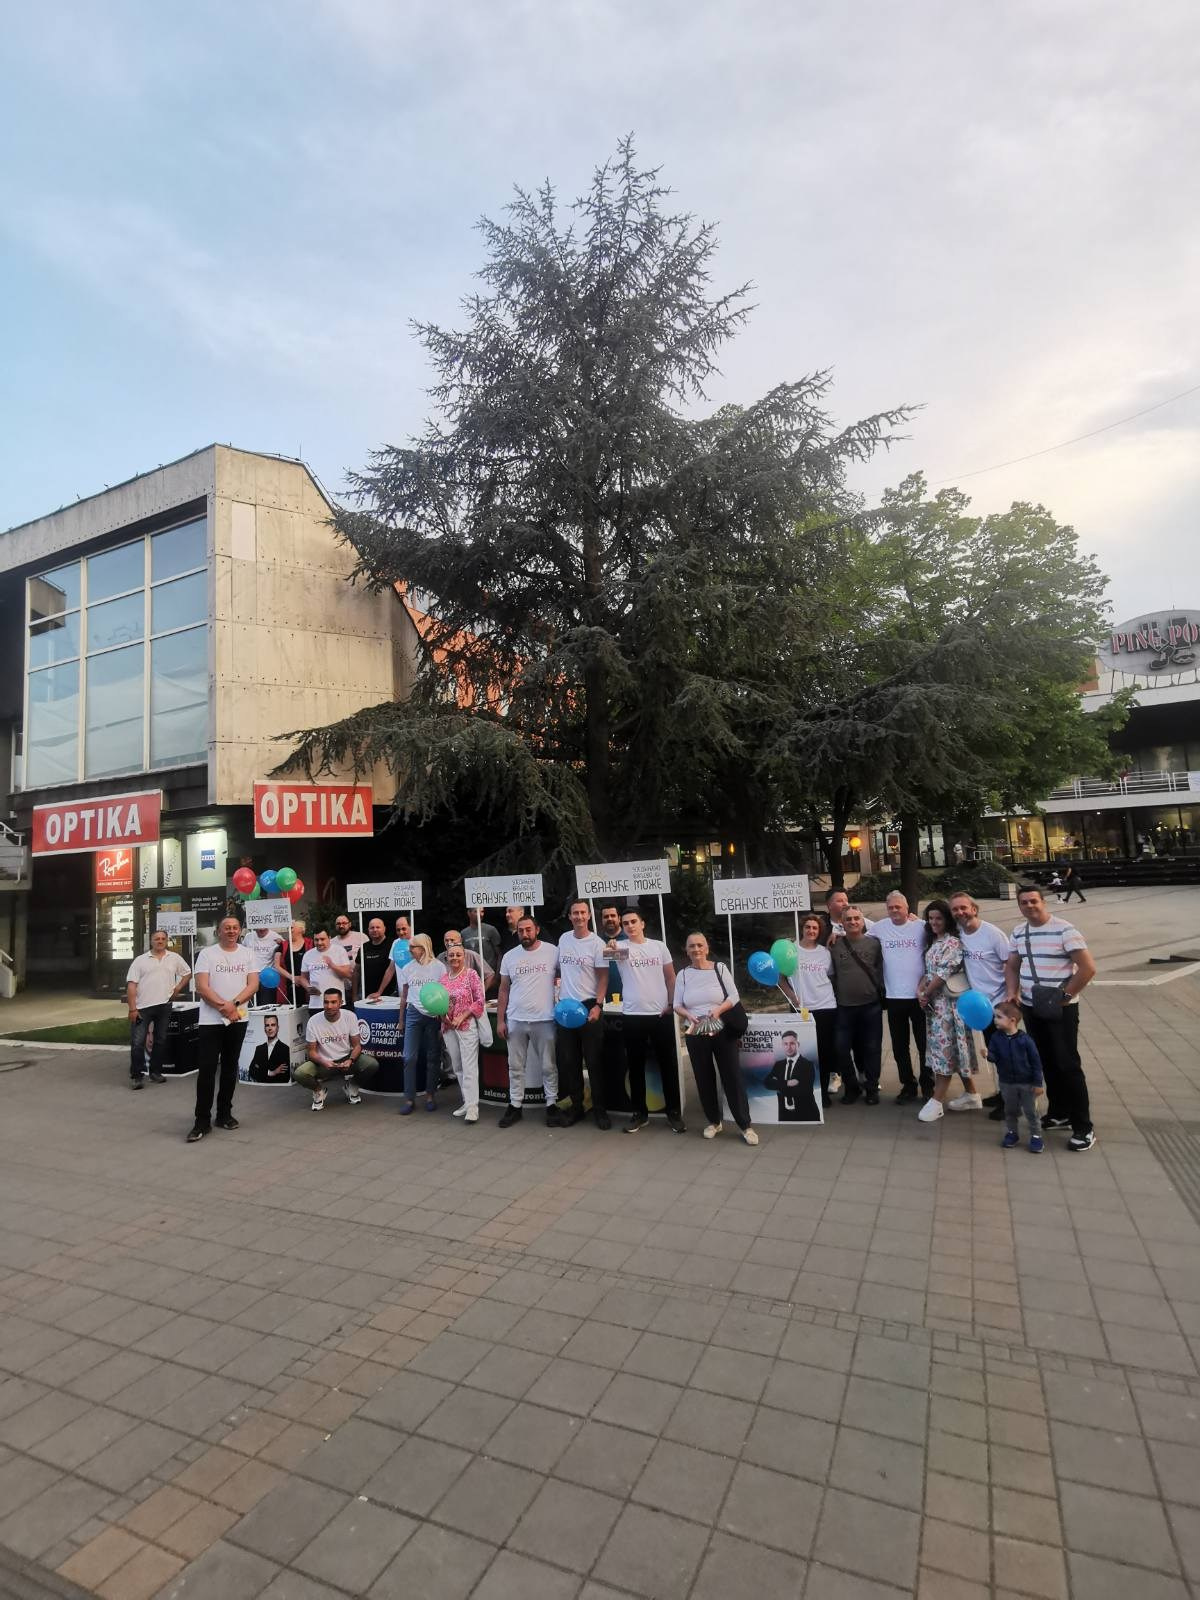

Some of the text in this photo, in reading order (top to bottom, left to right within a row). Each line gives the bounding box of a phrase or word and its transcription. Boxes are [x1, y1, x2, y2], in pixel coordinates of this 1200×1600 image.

[1168, 623, 1200, 646] PO
[261, 791, 368, 826] OPTIKA
[46, 803, 142, 845] OPTIKA
[584, 878, 663, 894] СВАНУЋЕ МОЖЕ
[353, 896, 416, 909] СВАНУЋЕ МОЖЕ
[471, 891, 536, 904] СВАНУЋЕ МОЖЕ
[720, 896, 804, 911] СВАНУЋЕ МОЖЕ
[371, 1037, 398, 1045] ПРАВДЕ
